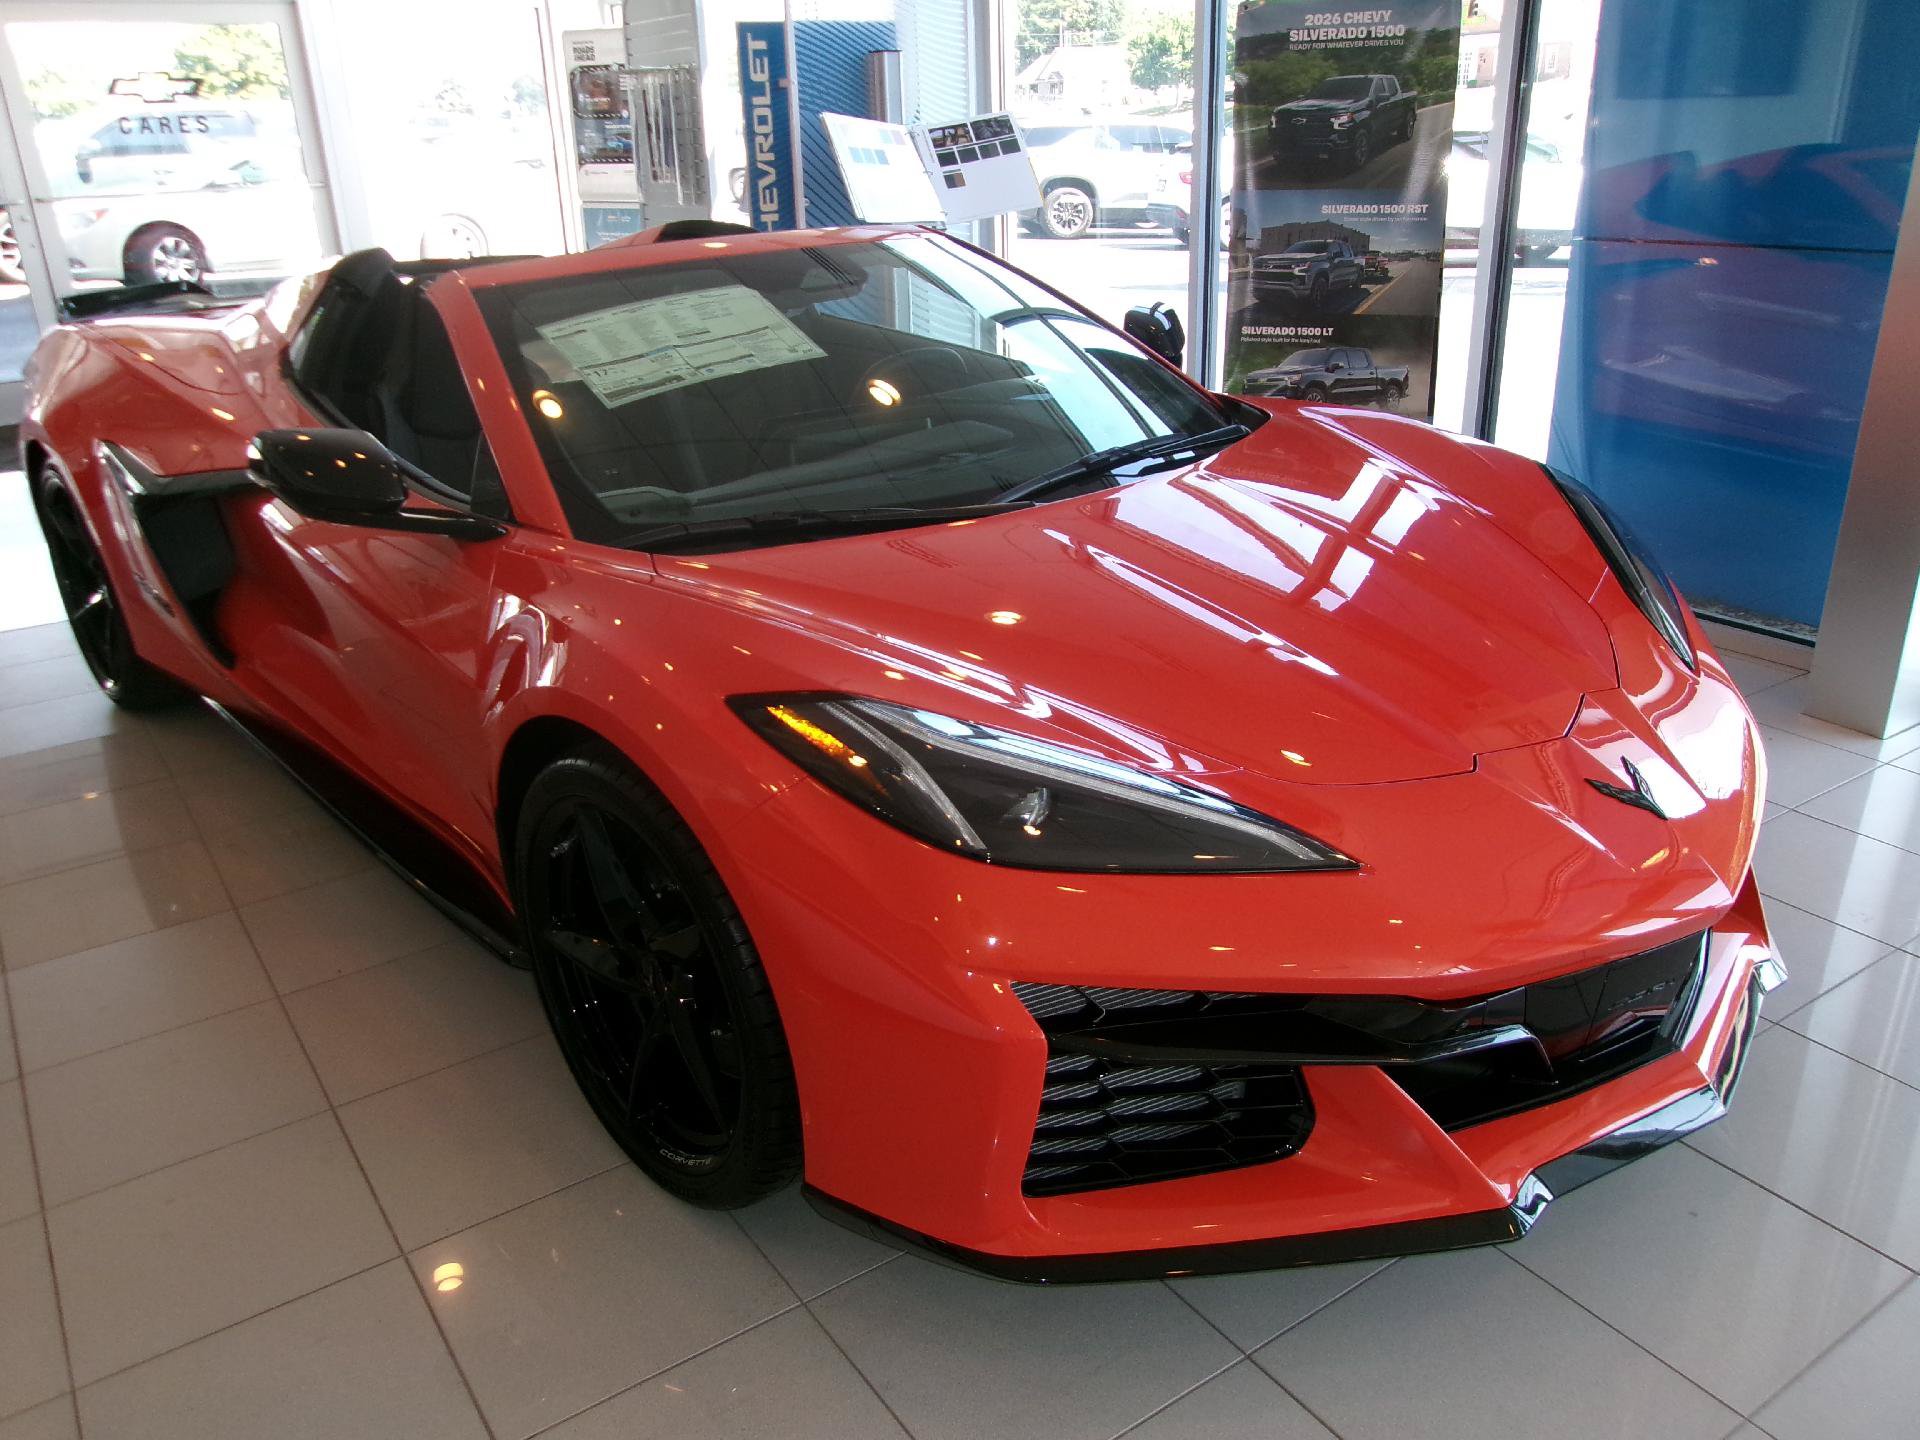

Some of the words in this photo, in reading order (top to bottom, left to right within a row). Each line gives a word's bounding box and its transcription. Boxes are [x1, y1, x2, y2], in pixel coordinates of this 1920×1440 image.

[1305, 13, 1341, 26] 2026
[1343, 10, 1392, 24] CHEVY
[1289, 26, 1367, 41] SILVERADO
[1369, 24, 1405, 38] 1500
[1289, 43, 1311, 51] READY
[1326, 40, 1363, 49] WHATEVER
[118, 115, 210, 135] CARES
[748, 32, 780, 233] HEVROLET
[1321, 204, 1378, 214] SILVERADO
[1379, 204, 1406, 214] 1500
[1407, 204, 1429, 213] RST
[1241, 326, 1296, 336] SILVERADO
[1297, 327, 1322, 336] 1500
[1322, 328, 1334, 336] LT
